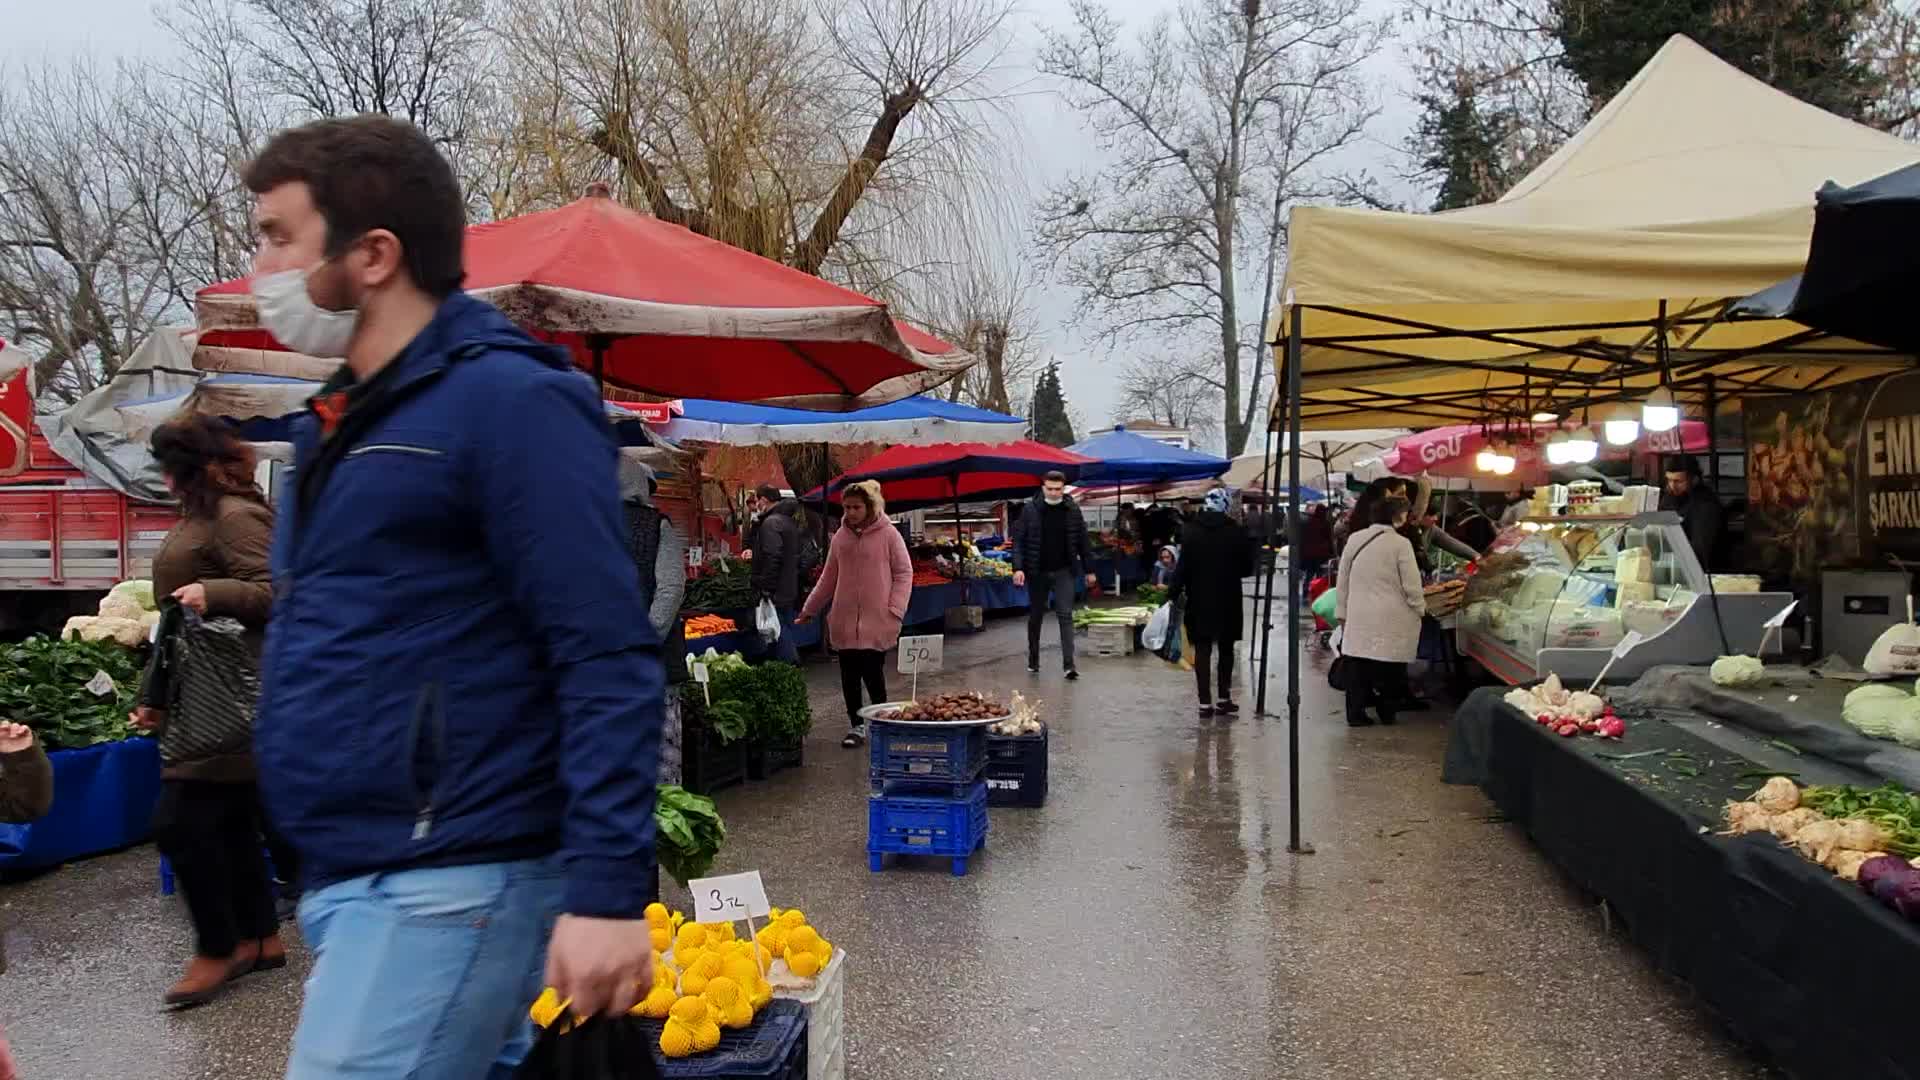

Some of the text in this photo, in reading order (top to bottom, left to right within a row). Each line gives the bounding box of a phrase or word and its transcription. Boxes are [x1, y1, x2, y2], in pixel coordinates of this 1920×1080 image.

[1420, 431, 1465, 464] Golf
[709, 888, 745, 911] 3 TL
